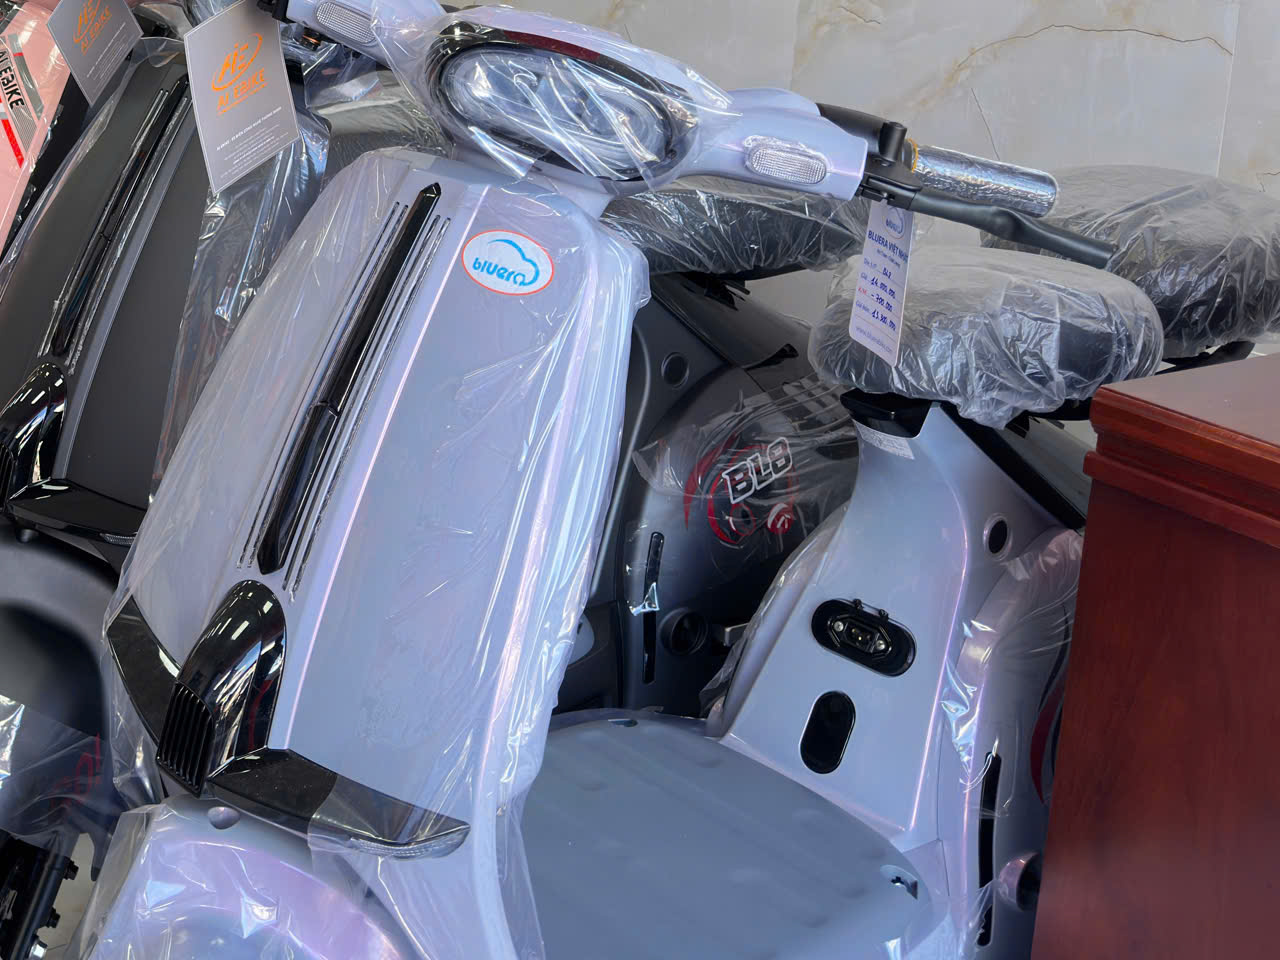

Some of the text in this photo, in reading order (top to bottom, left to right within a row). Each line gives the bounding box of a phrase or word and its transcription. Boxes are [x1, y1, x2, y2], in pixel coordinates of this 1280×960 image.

[0, 66, 25, 110] EBIKE
[233, 68, 265, 98] EBIKE
[868, 230, 889, 248] BLUERA
[472, 256, 531, 287] bluera
[722, 436, 792, 504] BL8
